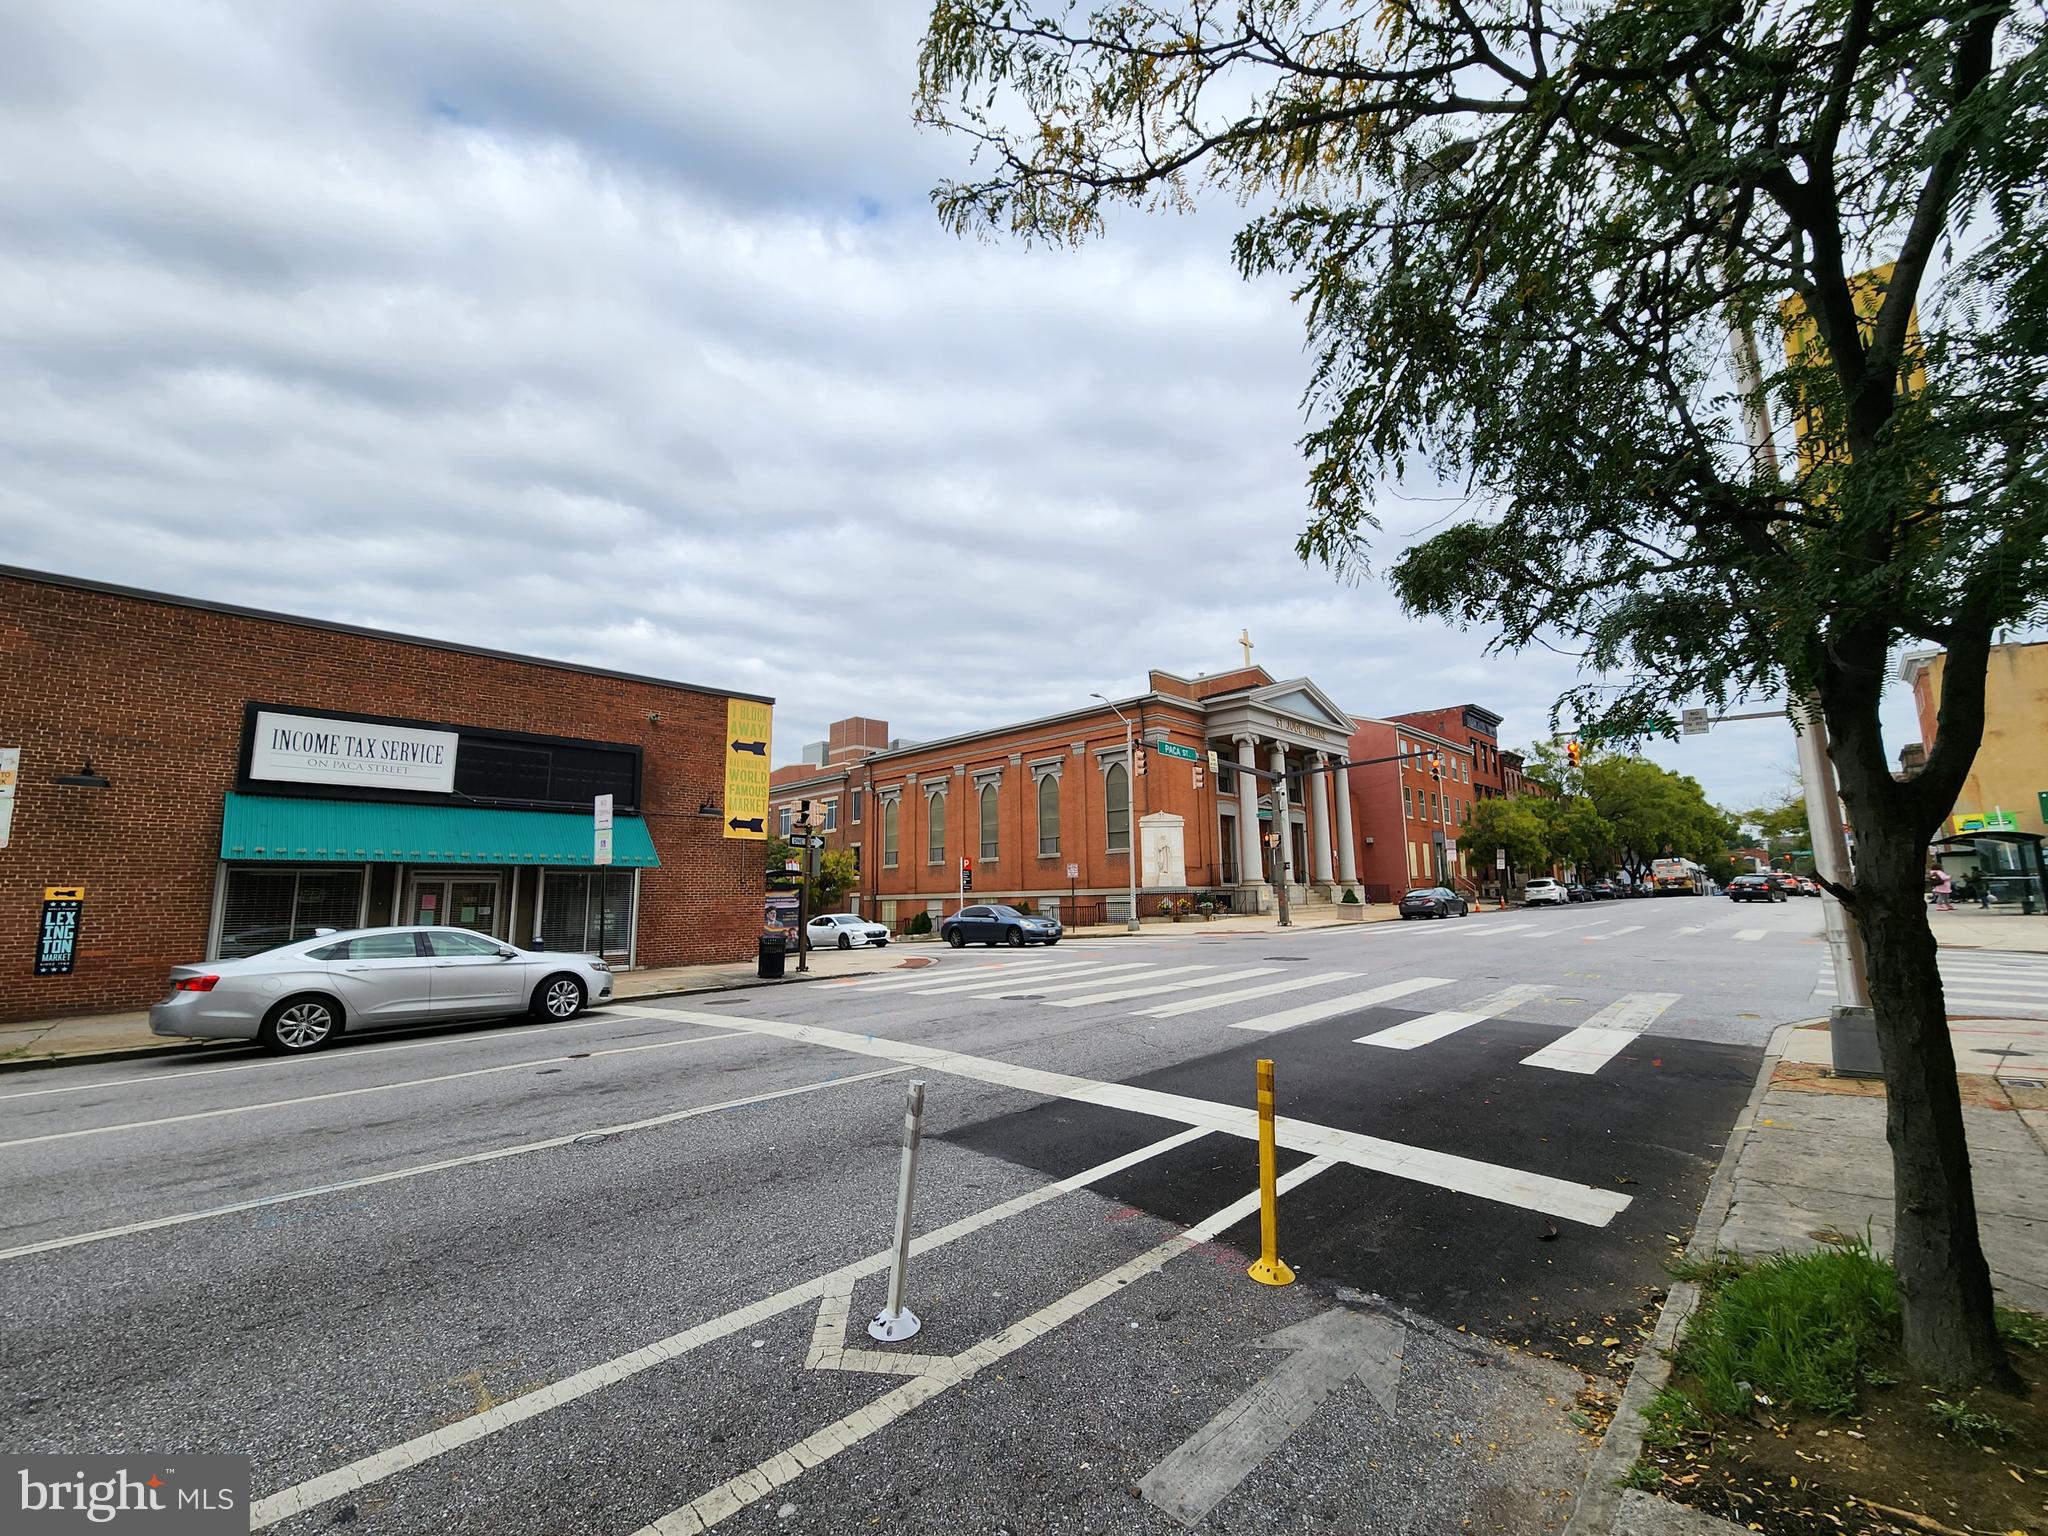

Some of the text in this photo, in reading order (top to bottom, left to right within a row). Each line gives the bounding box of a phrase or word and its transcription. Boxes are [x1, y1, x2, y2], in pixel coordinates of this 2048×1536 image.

[731, 703, 768, 722] 1 BLOCK
[731, 720, 768, 738] AWAY!
[272, 728, 444, 765] INCOME TAX SERVICE
[1164, 744, 1181, 756] PACA
[307, 758, 410, 775] ON PACA STREET
[729, 768, 767, 784] WORLD
[729, 783, 767, 798] FAMOUS
[728, 797, 767, 813] MARKET
[964, 859, 970, 868] P
[45, 911, 76, 926] LEX
[42, 926, 75, 940] ING
[42, 940, 73, 954] TON
[42, 953, 72, 962] MARKET
